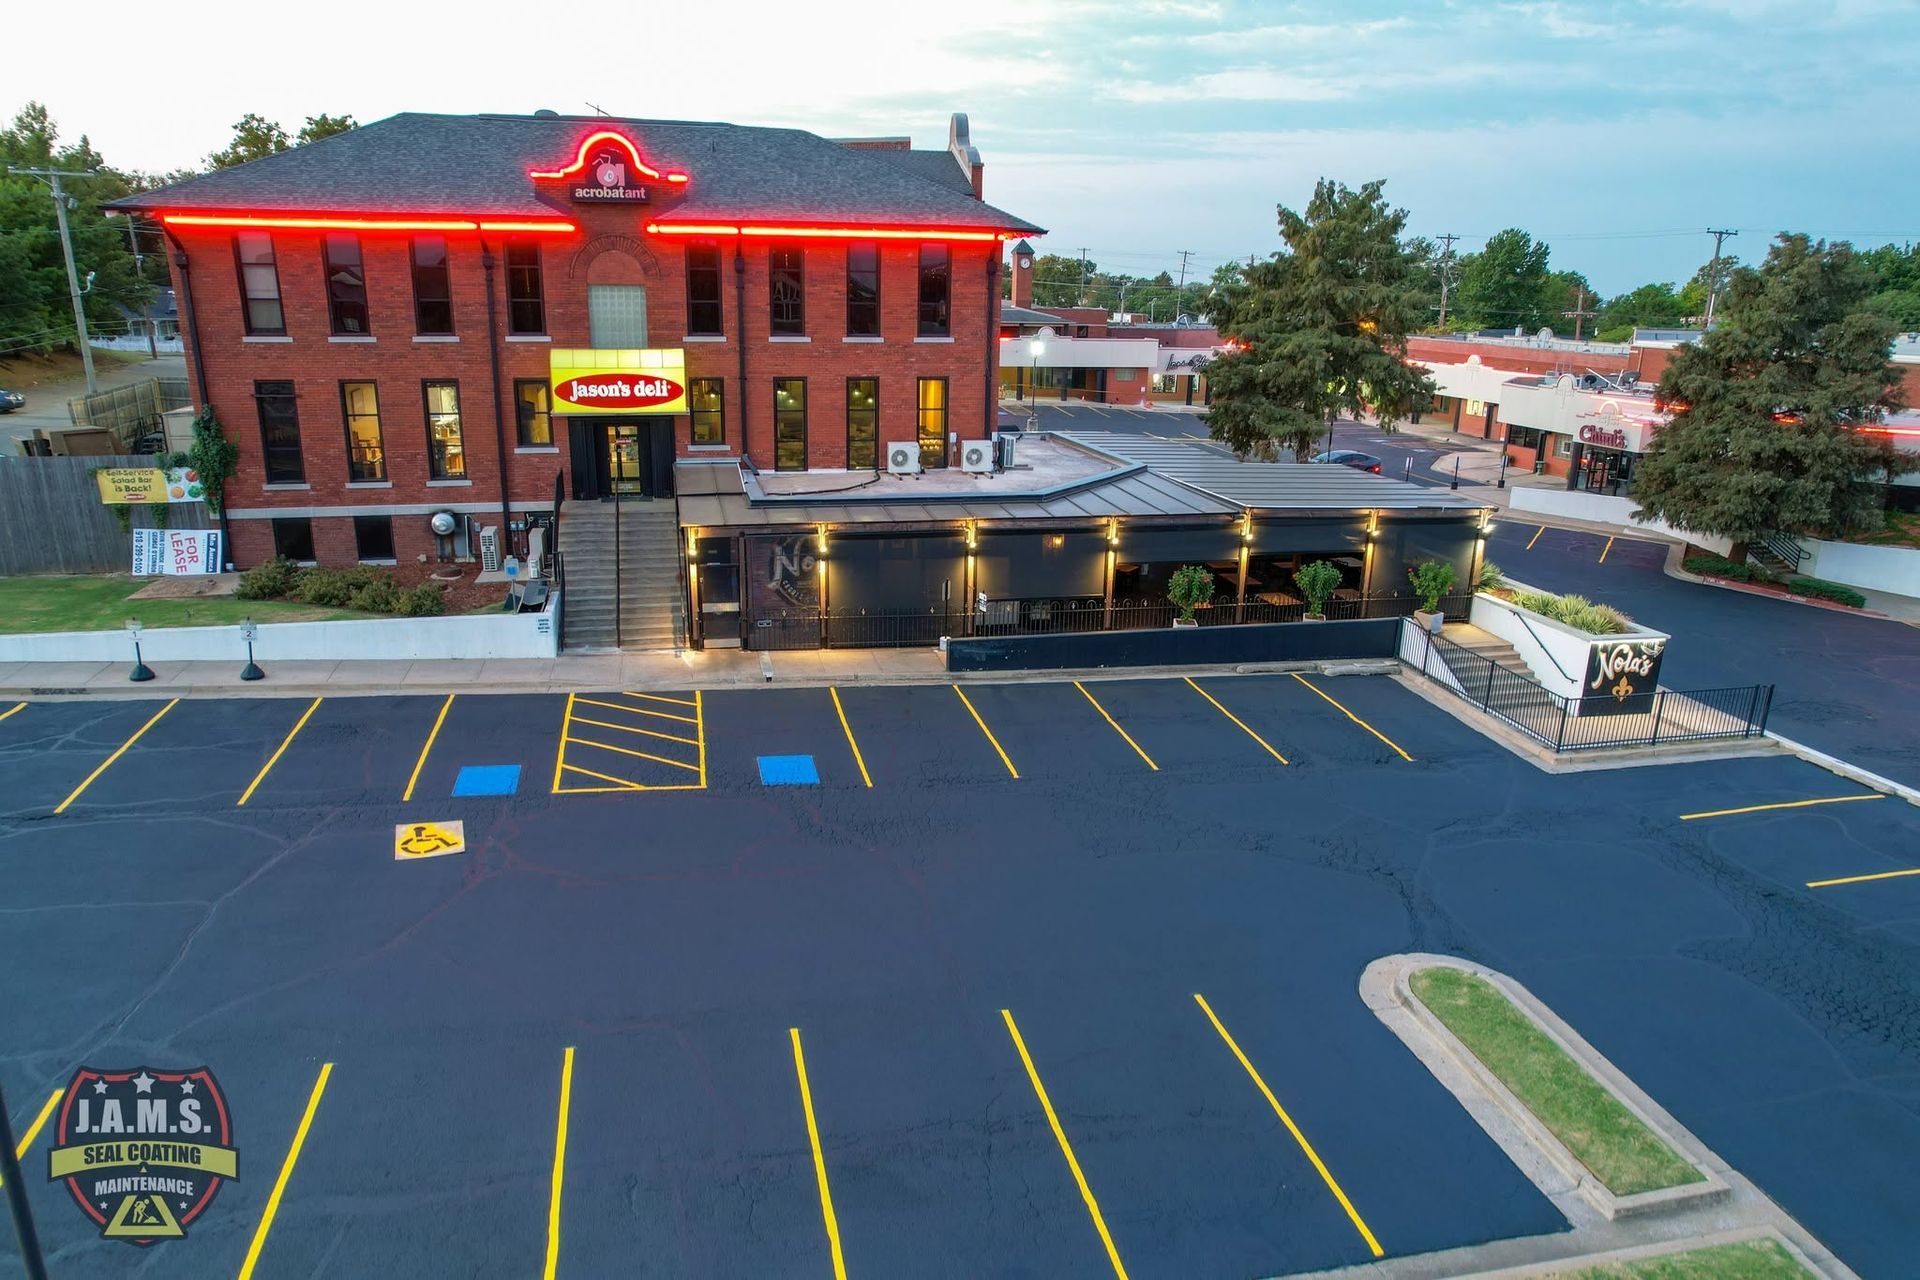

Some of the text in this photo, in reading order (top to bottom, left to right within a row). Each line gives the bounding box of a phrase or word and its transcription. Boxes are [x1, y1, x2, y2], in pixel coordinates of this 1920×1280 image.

[575, 186, 646, 199] acrobatant
[570, 380, 669, 402] Jason's deli
[115, 485, 152, 493] is Back!
[170, 532, 187, 574] LEASE
[185, 537, 199, 564] FOR
[1591, 643, 1653, 690] Nola's
